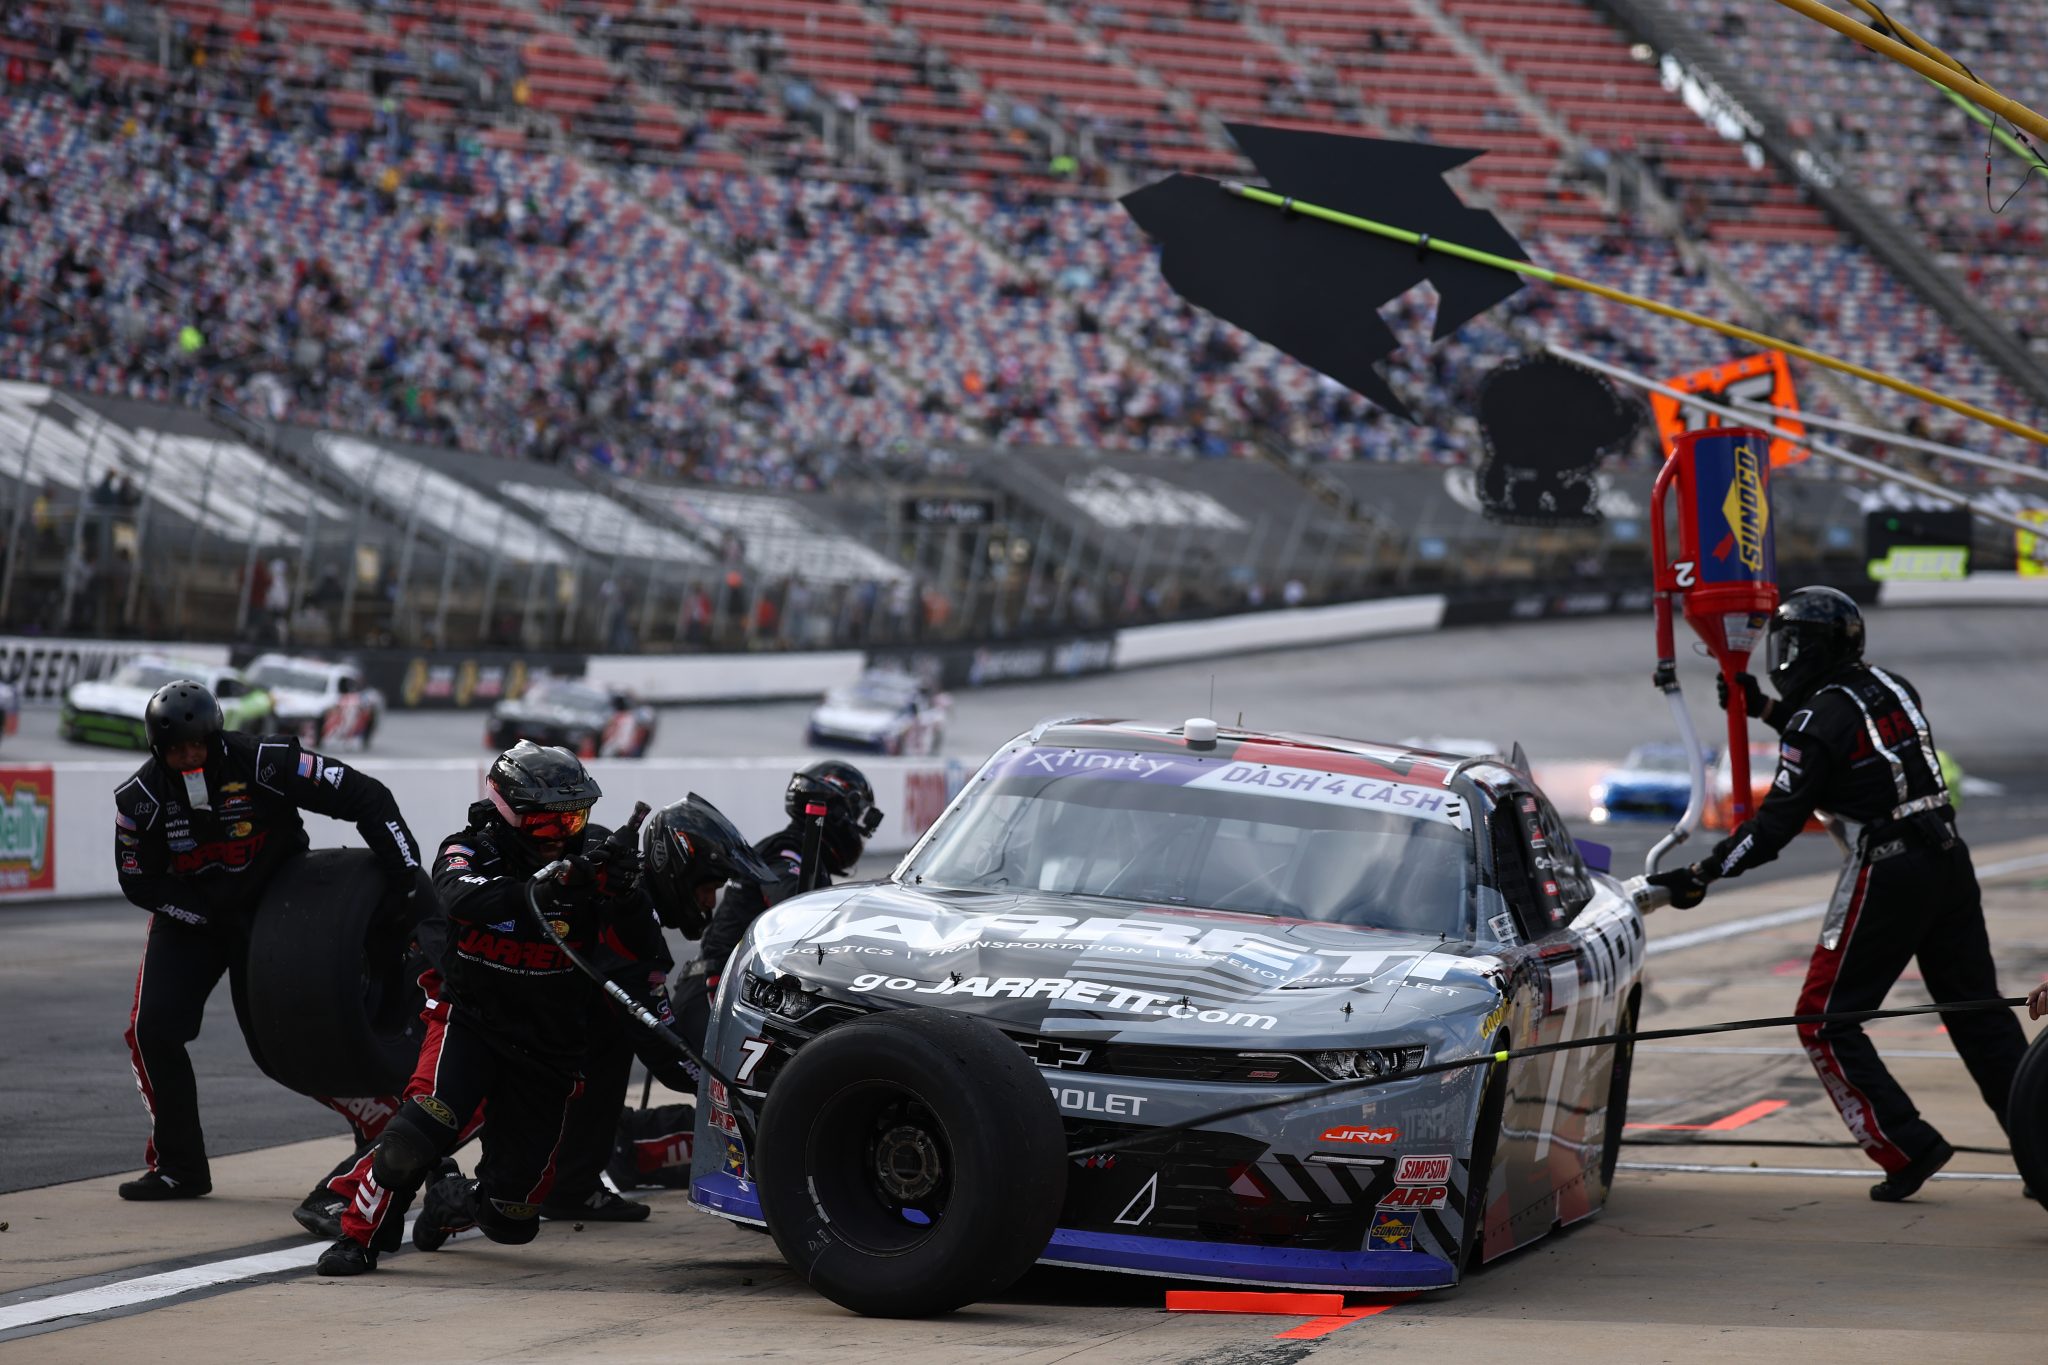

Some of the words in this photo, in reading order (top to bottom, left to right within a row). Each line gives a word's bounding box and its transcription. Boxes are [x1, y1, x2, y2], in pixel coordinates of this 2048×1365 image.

[1737, 449, 1760, 567] SUNOCO
[1673, 561, 1697, 588] 2
[1026, 752, 1174, 778] xfinity
[1222, 765, 1318, 791] DASH
[1323, 779, 1346, 796] 4
[1350, 784, 1448, 812] CASH
[384, 820, 420, 869] JARRETT
[765, 909, 1472, 982] JARRETT
[769, 945, 896, 960] LOGSTICS
[928, 940, 1143, 959] TRANSPORTATION
[1175, 951, 1354, 984] WAREHOUSING
[1386, 979, 1460, 997] FLEET
[735, 1038, 769, 1082] 7
[1325, 1130, 1393, 1143] JRM
[1401, 1159, 1449, 1179] SIMPSON
[1379, 1187, 1447, 1205] ARP
[1373, 1226, 1411, 1237] SUNOCO
